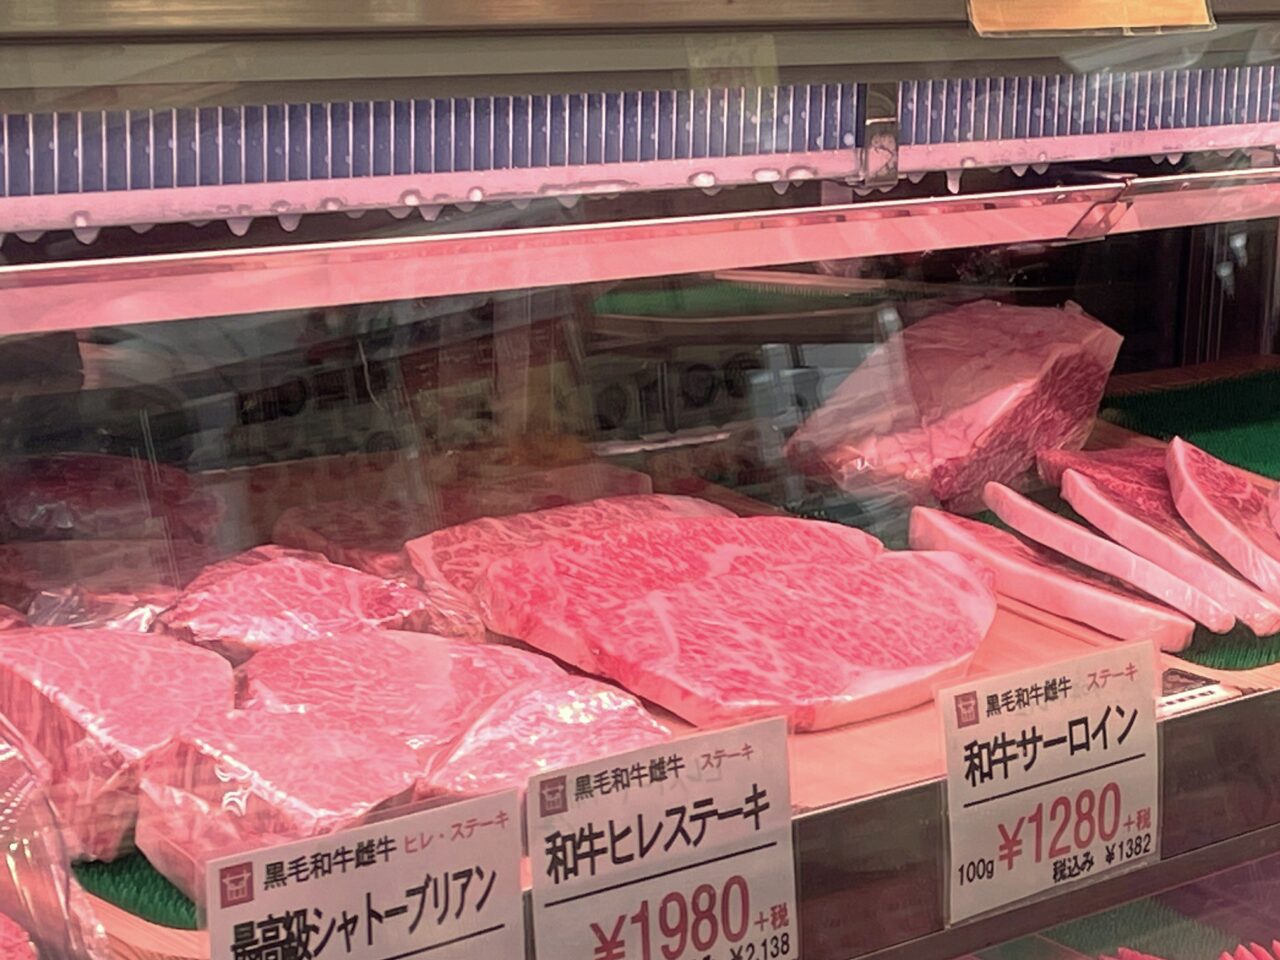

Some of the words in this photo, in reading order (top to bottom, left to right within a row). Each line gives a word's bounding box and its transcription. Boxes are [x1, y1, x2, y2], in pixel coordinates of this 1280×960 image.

[986, 676, 1072, 717] 黒毛和牛雌牛
[1087, 662, 1138, 690] ステーキ
[574, 754, 685, 801] 黒毛和牛雌牛
[701, 743, 754, 770] ステーキ
[963, 705, 1138, 787] 和牛サーロイン
[263, 836, 396, 890] 黒毛和牛雌牛
[404, 811, 509, 854] ヒレ・ステーキ
[545, 784, 770, 884] 和牛ヒレステーキ
[958, 859, 994, 885] 100g
[997, 782, 1121, 871] ¥1280
[1053, 851, 1095, 883] 税込み
[1105, 833, 1151, 864] ¥1382
